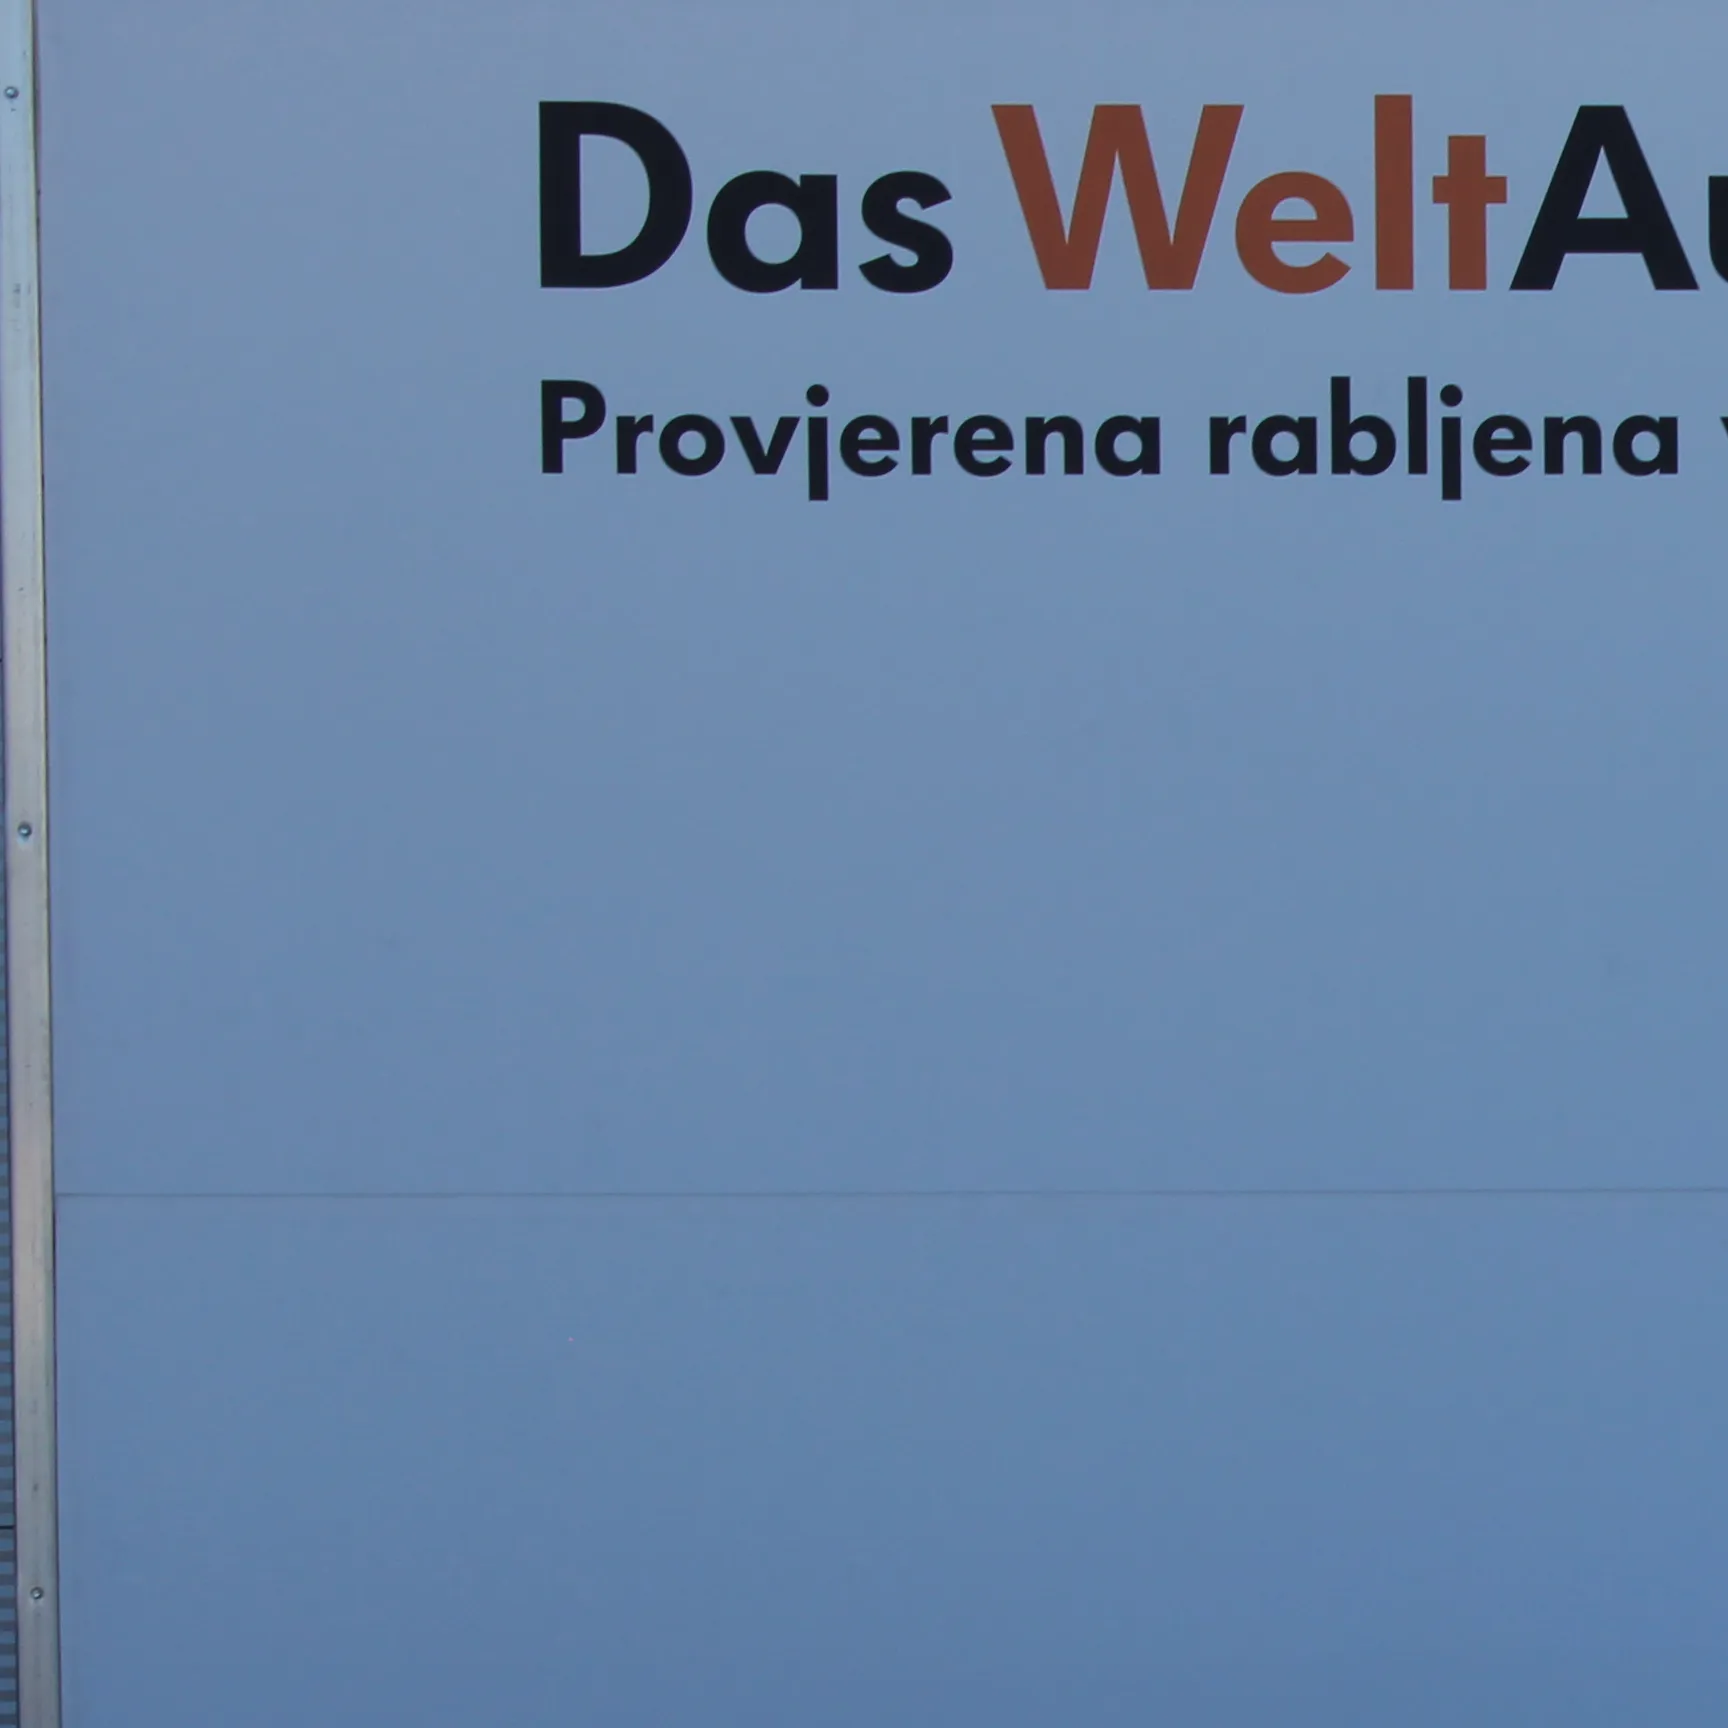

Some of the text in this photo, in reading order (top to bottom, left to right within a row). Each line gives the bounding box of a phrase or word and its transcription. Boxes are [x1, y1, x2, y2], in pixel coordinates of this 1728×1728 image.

[538, 100, 954, 295] Das
[540, 379, 1161, 502] Provjerena
[1208, 375, 1679, 501] rabljena
